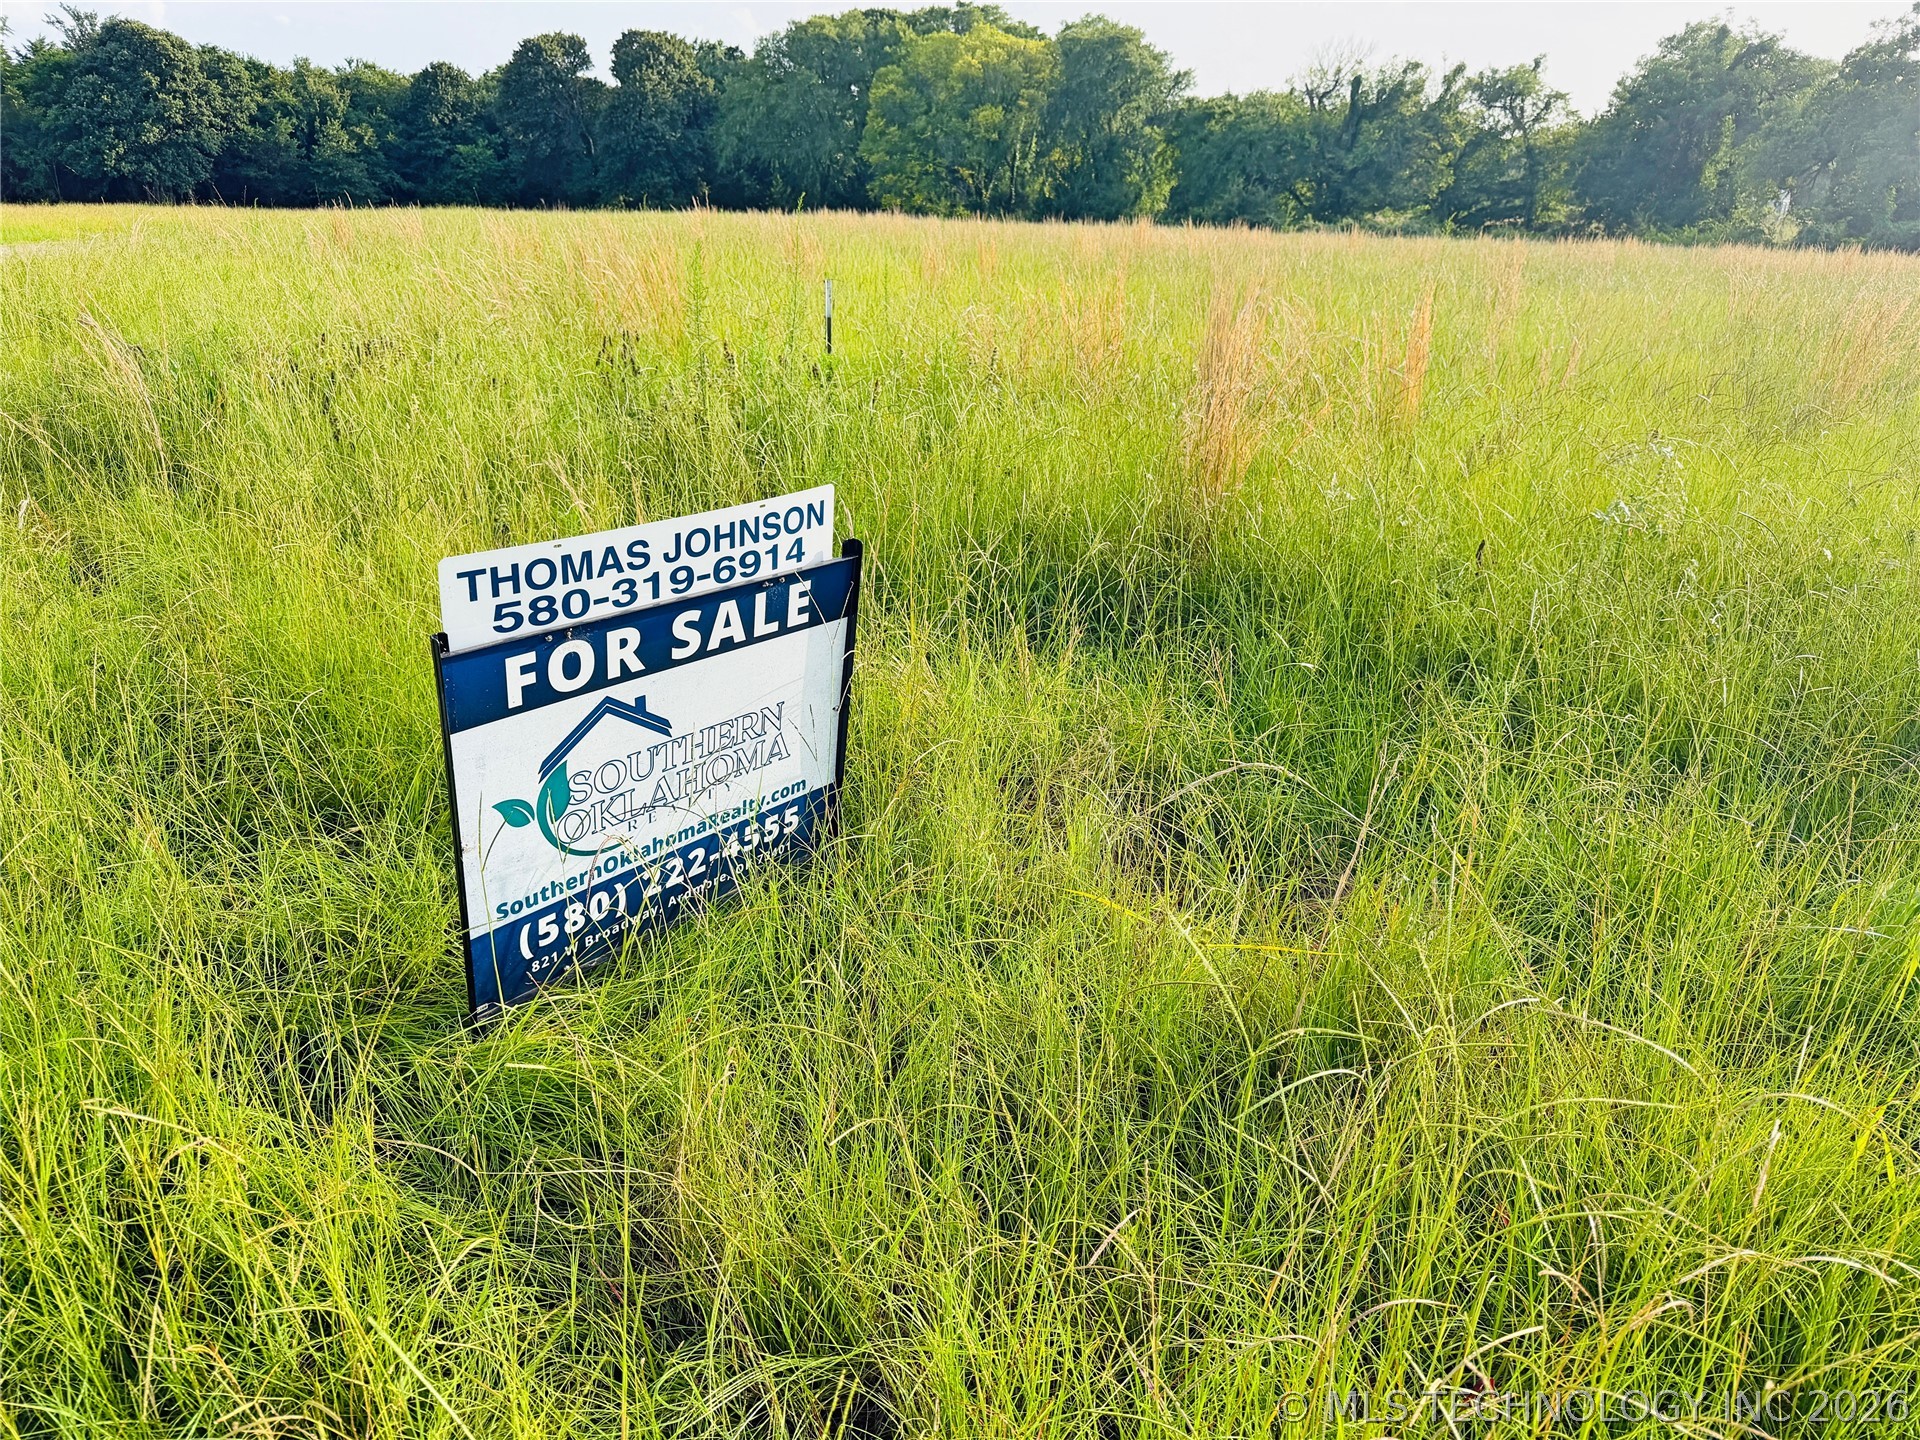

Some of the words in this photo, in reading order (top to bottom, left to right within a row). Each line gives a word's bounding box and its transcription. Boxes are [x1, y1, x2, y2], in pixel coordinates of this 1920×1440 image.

[456, 539, 651, 602] THOMAS
[663, 500, 826, 563] JOHNSON
[492, 537, 806, 633] 580-319-6914
[504, 626, 646, 709] FOR
[671, 580, 812, 660] SALE
[556, 734, 791, 845] OKLAHOMA
[567, 701, 785, 806] SOUTHERN
[496, 778, 807, 922] SouthernOklahomaRealty.com
[520, 882, 627, 960] (580)
[643, 805, 800, 900] 222-4555
[531, 951, 558, 973] 821
[564, 941, 579, 956] W
